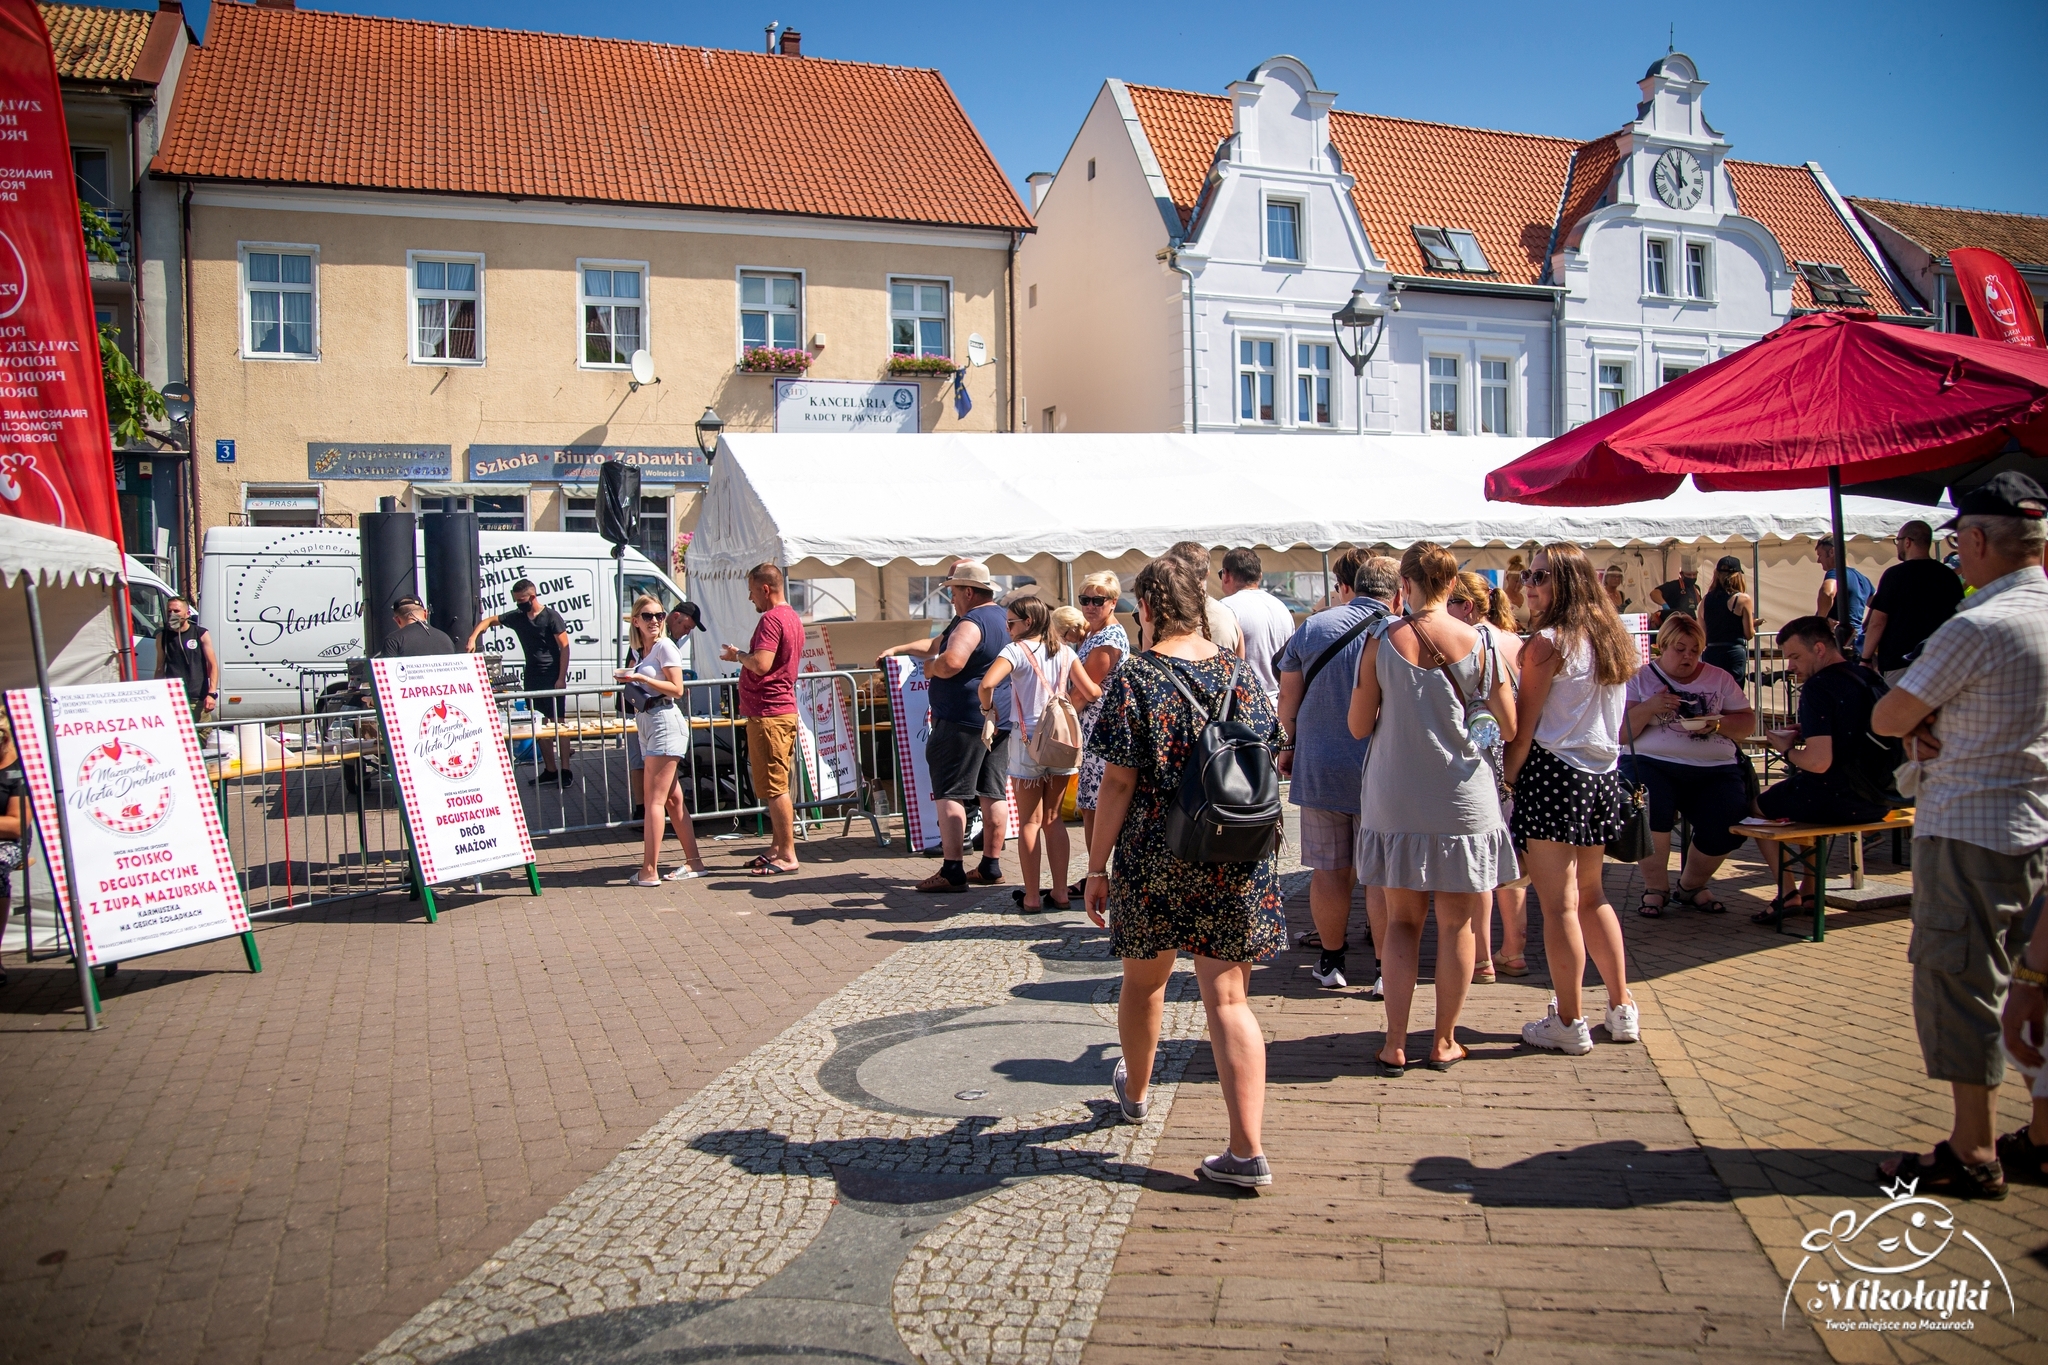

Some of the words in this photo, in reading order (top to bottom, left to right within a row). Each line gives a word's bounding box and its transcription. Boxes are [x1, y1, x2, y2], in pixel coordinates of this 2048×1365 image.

[810, 396, 887, 409] KANCELARIA
[805, 413, 837, 422] RADCY
[841, 414, 892, 424] PRAWNEGO
[220, 445, 230, 459] 3
[475, 451, 540, 477] Szkoła
[553, 450, 606, 464] Biuro
[614, 450, 694, 465] Zabawki
[563, 468, 600, 479] KSIĘGA
[268, 500, 298, 508] PRASA
[400, 684, 457, 699] ZAPRASZA
[458, 682, 474, 694] NA
[54, 717, 138, 738] ZAPRASZA
[141, 715, 165, 729] NA
[443, 726, 483, 750] Drobiowa
[91, 761, 147, 784] Mazurska
[115, 767, 176, 799] Drobiowa
[446, 793, 483, 808] STOISKO
[436, 806, 501, 826] DEGUSTACYJNE
[460, 823, 486, 838] DRÓB
[454, 838, 497, 855] SMAŻONY
[116, 850, 173, 870] STOISKO
[99, 864, 199, 893] DEGUSTACYJNE
[89, 902, 100, 915] Z
[104, 894, 142, 913] ZUPĄ
[145, 880, 218, 904] MAZURSKĄ
[137, 904, 181, 918] KARMUSZKA
